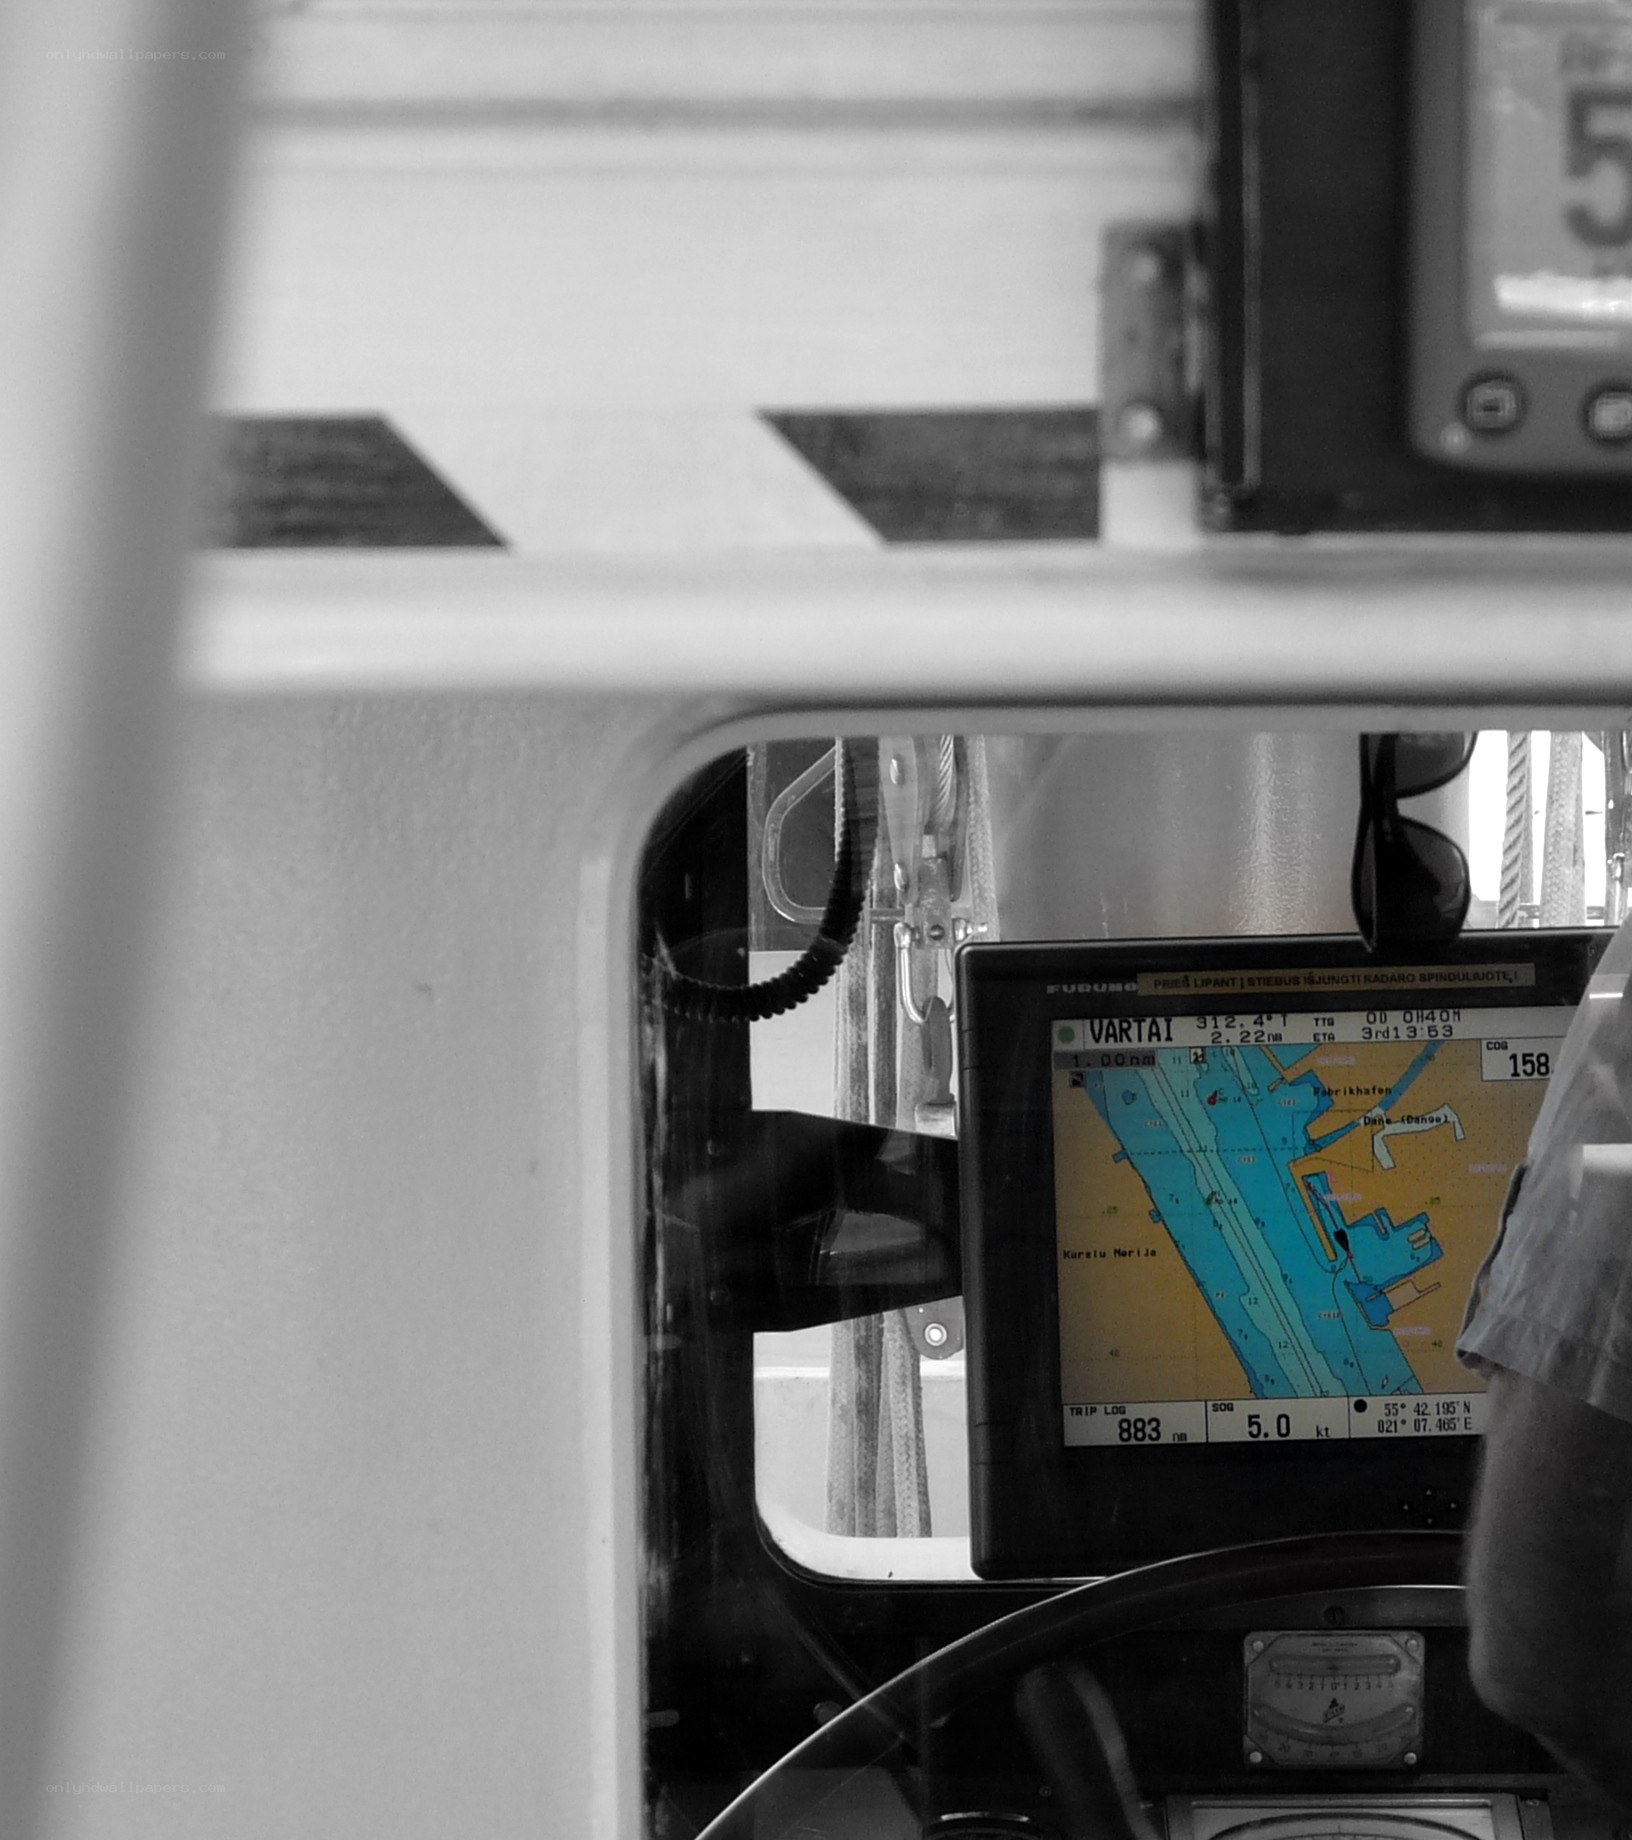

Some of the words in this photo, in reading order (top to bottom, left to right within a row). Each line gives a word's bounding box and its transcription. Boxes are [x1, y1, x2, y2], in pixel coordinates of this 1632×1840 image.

[1194, 976, 1236, 988] LIPANT
[1247, 975, 1300, 987] STIEBUS
[1364, 972, 1415, 984] RADARO
[1047, 982, 1138, 994] FURUNO
[1314, 1017, 1335, 1027] TTG
[1090, 1017, 1174, 1044] VARTAI
[1313, 1033, 1336, 1043] ETA
[1486, 1041, 1508, 1050] COG
[1363, 1115, 1392, 1126] Dane
[1069, 1407, 1097, 1416] TRIP
[1104, 1406, 1126, 1415] LOG
[1212, 1403, 1234, 1412] SOG
[1247, 1413, 1291, 1439] 5.0
[1315, 1425, 1331, 1438] kt
[1464, 1417, 1472, 1430] E
[1118, 1417, 1162, 1442] 883
